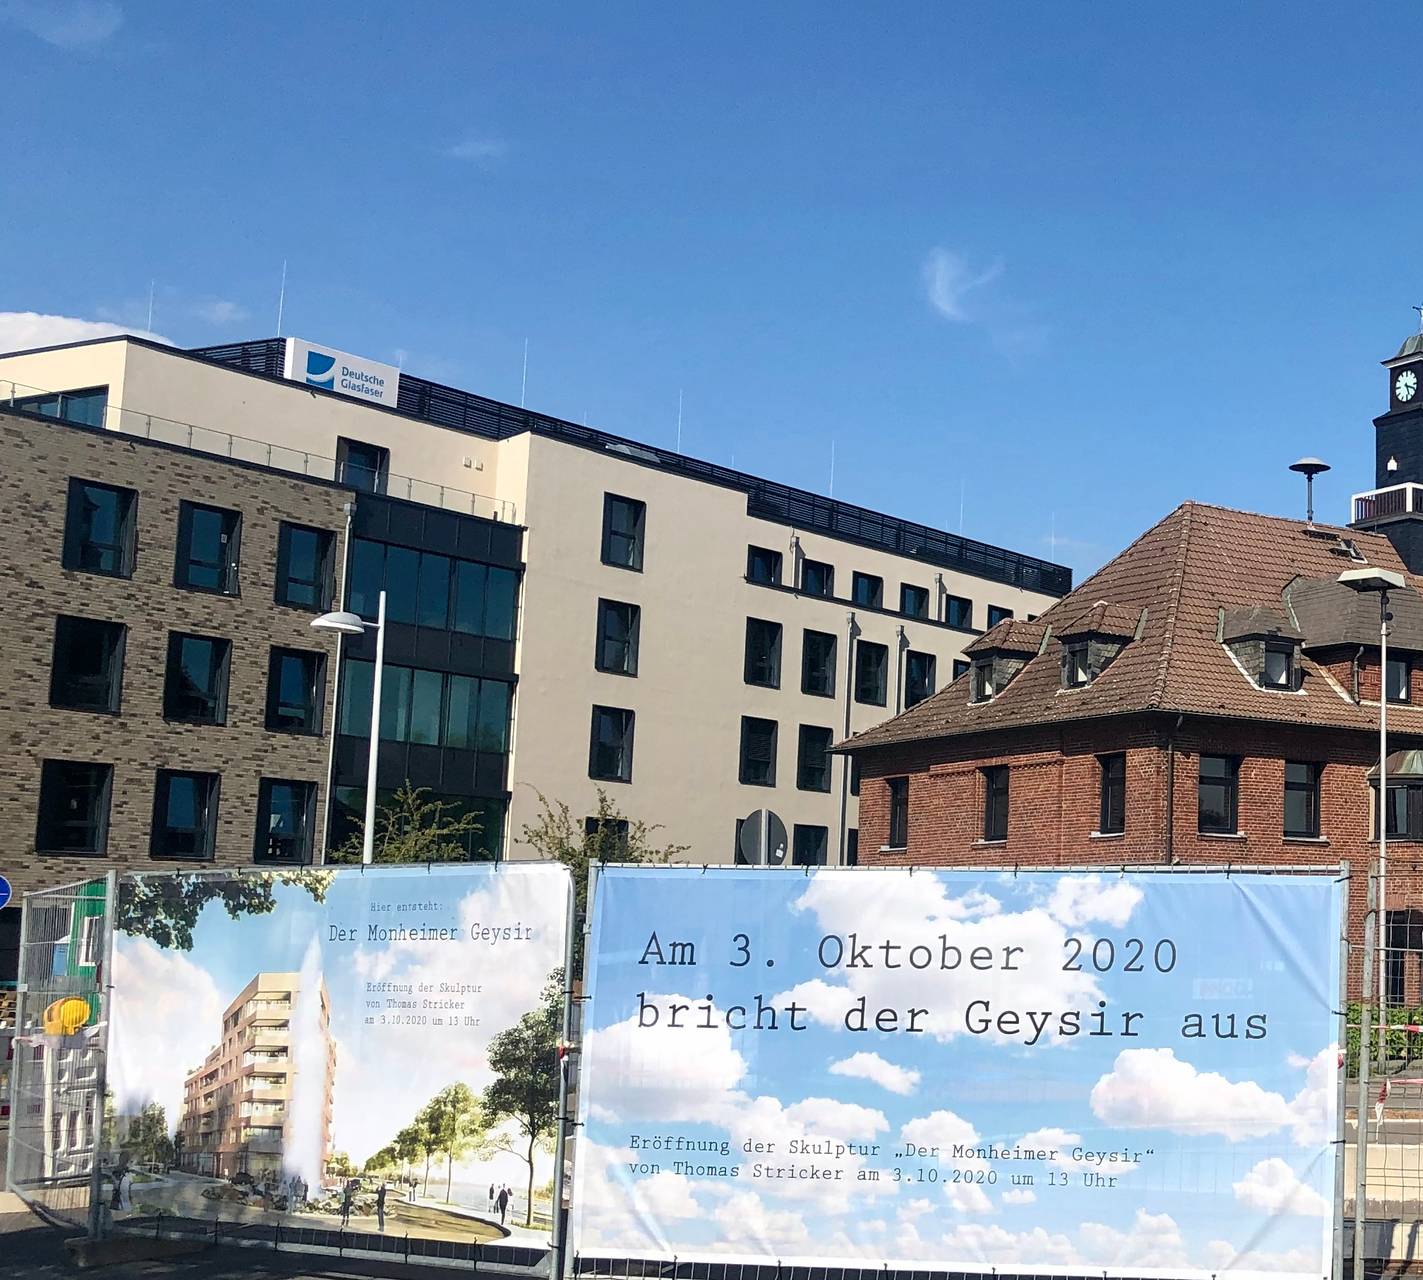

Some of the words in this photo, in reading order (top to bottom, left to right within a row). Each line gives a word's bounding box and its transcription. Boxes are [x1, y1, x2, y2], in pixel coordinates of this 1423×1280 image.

[342, 366, 384, 387] Deutsche
[340, 378, 384, 398] Glasfaser
[370, 902, 391, 912] Hier
[396, 901, 444, 912] entsteht:
[328, 924, 358, 942] Der
[368, 922, 458, 942] Monheimer
[470, 922, 532, 946] Geysir
[638, 930, 697, 966] Am
[729, 933, 775, 968] 3.
[817, 932, 1024, 970] Oktober
[1061, 938, 1177, 973] 2020
[366, 982, 413, 995] Eröffnung
[418, 982, 434, 992] der
[439, 982, 482, 996] Skulptur
[366, 1000, 380, 1008] von
[386, 998, 418, 1009] Thomas
[422, 999, 465, 1010] Stricker
[364, 1016, 375, 1024] am
[380, 1015, 428, 1025] 3.10.2020
[432, 1017, 444, 1026] um
[448, 1016, 459, 1026] 13
[464, 1016, 481, 1026] Uhr
[636, 992, 807, 1030] bricht
[844, 996, 930, 1032] der
[965, 1000, 1144, 1046] Geysir
[1180, 1011, 1267, 1040] aus
[629, 1135, 730, 1156] Eröffnung
[743, 1138, 776, 1154] der
[788, 1140, 880, 1159] Skulptur
[894, 1143, 940, 1158] „Der
[952, 1144, 1058, 1162] Monheimer
[1072, 1147, 1154, 1166] Geysir“
[628, 1162, 661, 1174] von
[673, 1161, 740, 1178] Thomas
[752, 1164, 844, 1180] Stricker
[857, 1169, 880, 1182] am
[892, 1167, 998, 1185] 3.10.2020
[1011, 1174, 1035, 1186] um
[1048, 1172, 1069, 1187] 13
[1083, 1173, 1118, 1188] Uhr
